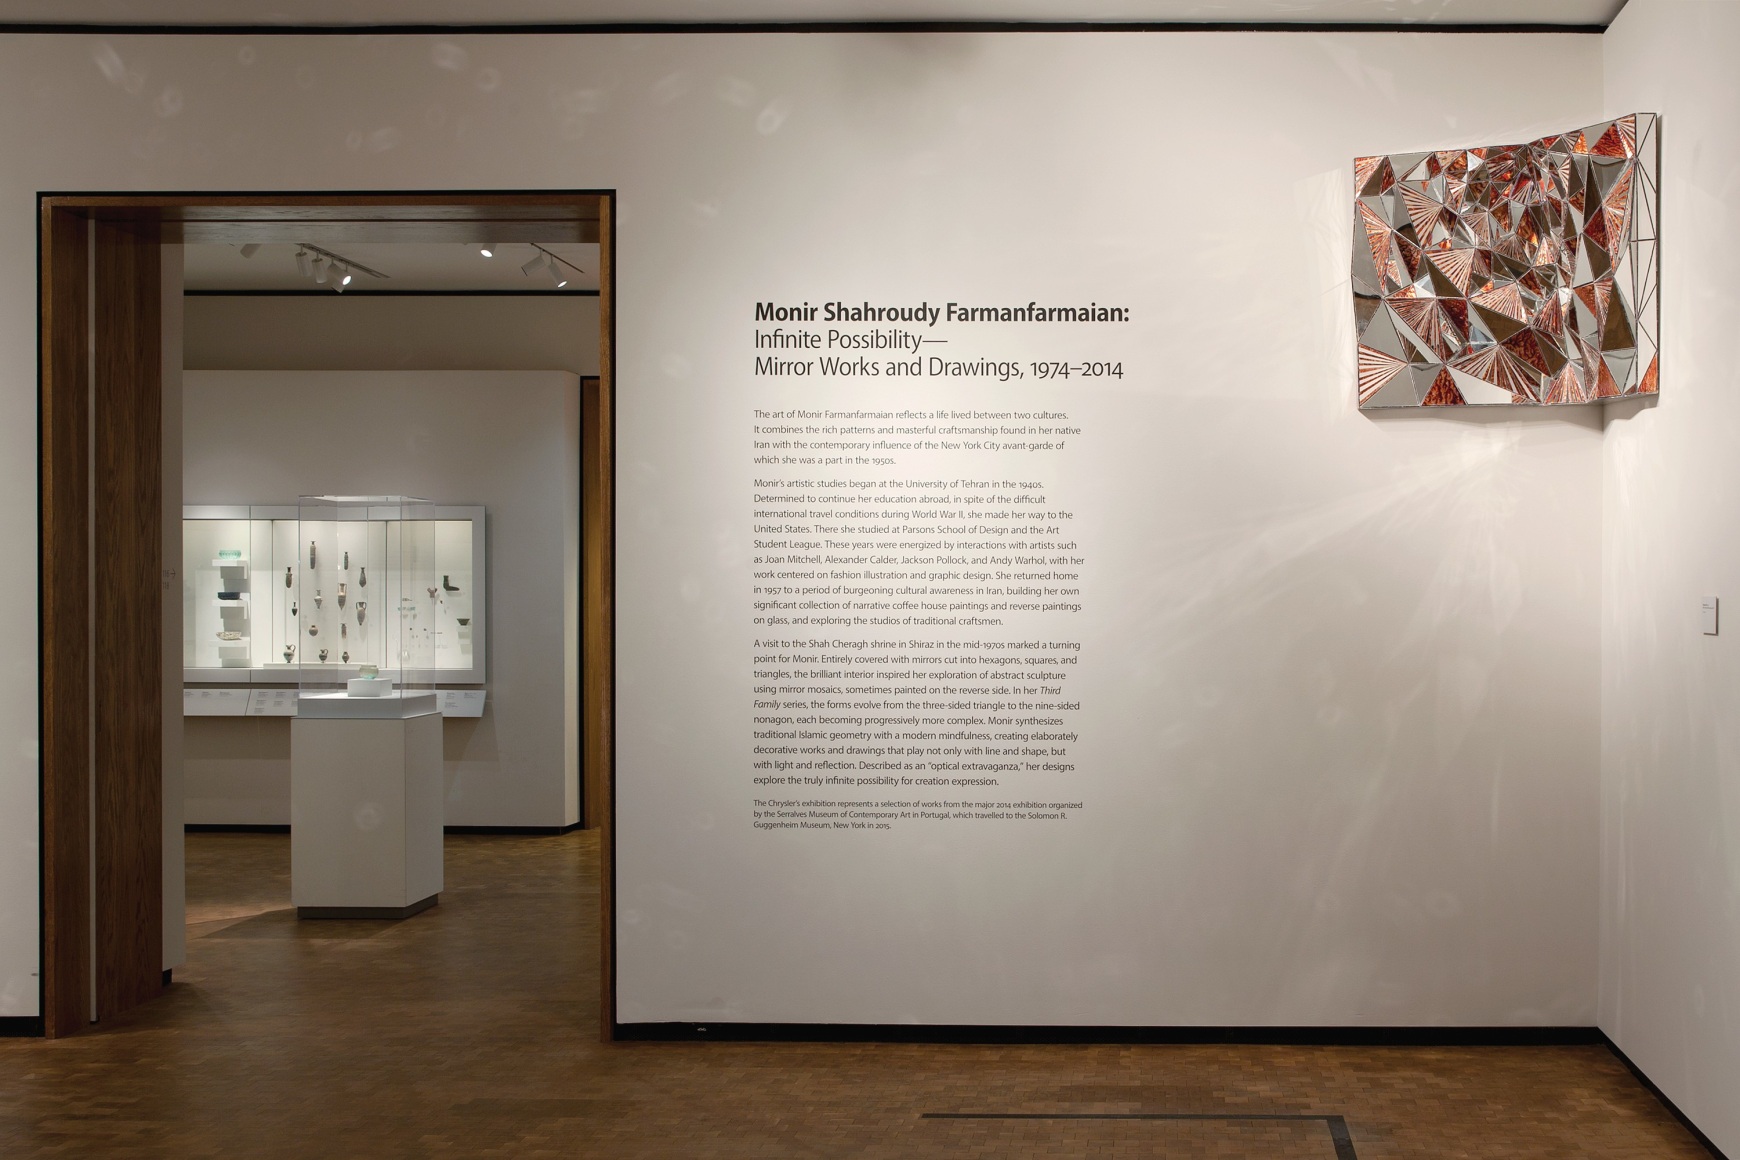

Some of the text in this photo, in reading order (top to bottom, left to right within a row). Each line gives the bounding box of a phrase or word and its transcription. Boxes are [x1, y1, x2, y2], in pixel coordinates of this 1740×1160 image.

[755, 302, 1129, 327] Monir Shahroudy Farmanfarmaian:
[756, 328, 948, 354] Infinite Possibility—
[755, 356, 1124, 382] Mirror Works and Drawings, 1974–2014
[754, 409, 770, 418] The
[772, 410, 784, 418] art
[786, 409, 796, 419] of
[798, 409, 823, 419] Monir
[825, 409, 893, 419] Farmanfarmaian
[896, 409, 927, 419] reflects
[937, 409, 949, 419] life
[951, 409, 971, 419] lived
[974, 409, 1011, 419] between
[1014, 410, 1031, 419] two
[1033, 410, 1068, 419] cultures.
[754, 439, 1065, 452] Iran with the contemporary influence of the New York City avant-garde of
[754, 478, 1044, 491] Monir’s artistic studies began at the University of Tehran in the 1940s.
[754, 509, 807, 518] international
[809, 509, 833, 518] travel
[835, 509, 879, 519] conditions
[881, 509, 909, 521] during
[912, 509, 937, 519] World
[939, 509, 957, 519] War
[968, 509, 982, 519] she
[985, 509, 1009, 519] made
[1011, 510, 1026, 519] her
[1028, 512, 1045, 522] way
[1047, 511, 1057, 519] to
[1059, 510, 1073, 519] the
[765, 554, 785, 565] Joan
[787, 554, 822, 566] Mitchell,
[824, 554, 868, 564] Alexander
[870, 554, 898, 566] Calder,
[900, 554, 934, 566] Jackson
[936, 555, 969, 566] Pollock,
[971, 555, 988, 564] and
[990, 555, 1013, 567] Andy
[1015, 555, 1047, 567] Warhol,
[1049, 555, 1068, 565] with
[1070, 555, 1084, 565] her
[754, 600, 797, 612] significant
[799, 600, 840, 610] collection
[842, 600, 851, 610] of
[853, 600, 890, 610] narrative
[892, 600, 919, 610] coffee
[921, 601, 948, 610] house
[950, 601, 989, 613] paintings
[991, 601, 1007, 611] and
[1042, 601, 1081, 613] paintings
[754, 654, 1077, 667] point for Monir. Entirely covered with mirrors cut into hexagons, squares, and
[754, 699, 1080, 712] Family series, the forms evolve from the three-sided triangle to the nine-sided
[754, 775, 999, 788] explore the truly infinite possibility for creation expression.
[768, 800, 800, 809] Chrysler’s
[802, 800, 836, 808] exhibition
[838, 801, 873, 810] represents
[922, 801, 942, 809] works
[944, 801, 960, 809] from
[962, 801, 973, 809] the
[975, 801, 995, 811] major
[997, 803, 1011, 811] 2014
[1049, 802, 1082, 811] organized
[754, 810, 762, 820] by
[764, 810, 775, 818] the
[777, 810, 807, 818] Serralves
[849, 811, 898, 820] Contemporary
[900, 811, 910, 819] Art
[912, 811, 919, 819] in
[921, 811, 951, 821] Portugal,
[1015, 812, 1026, 820] the
[1028, 812, 1059, 820] Solomon
[1061, 812, 1067, 820] R.
[754, 821, 798, 831] Guggenheim
[800, 821, 832, 830] Museum,
